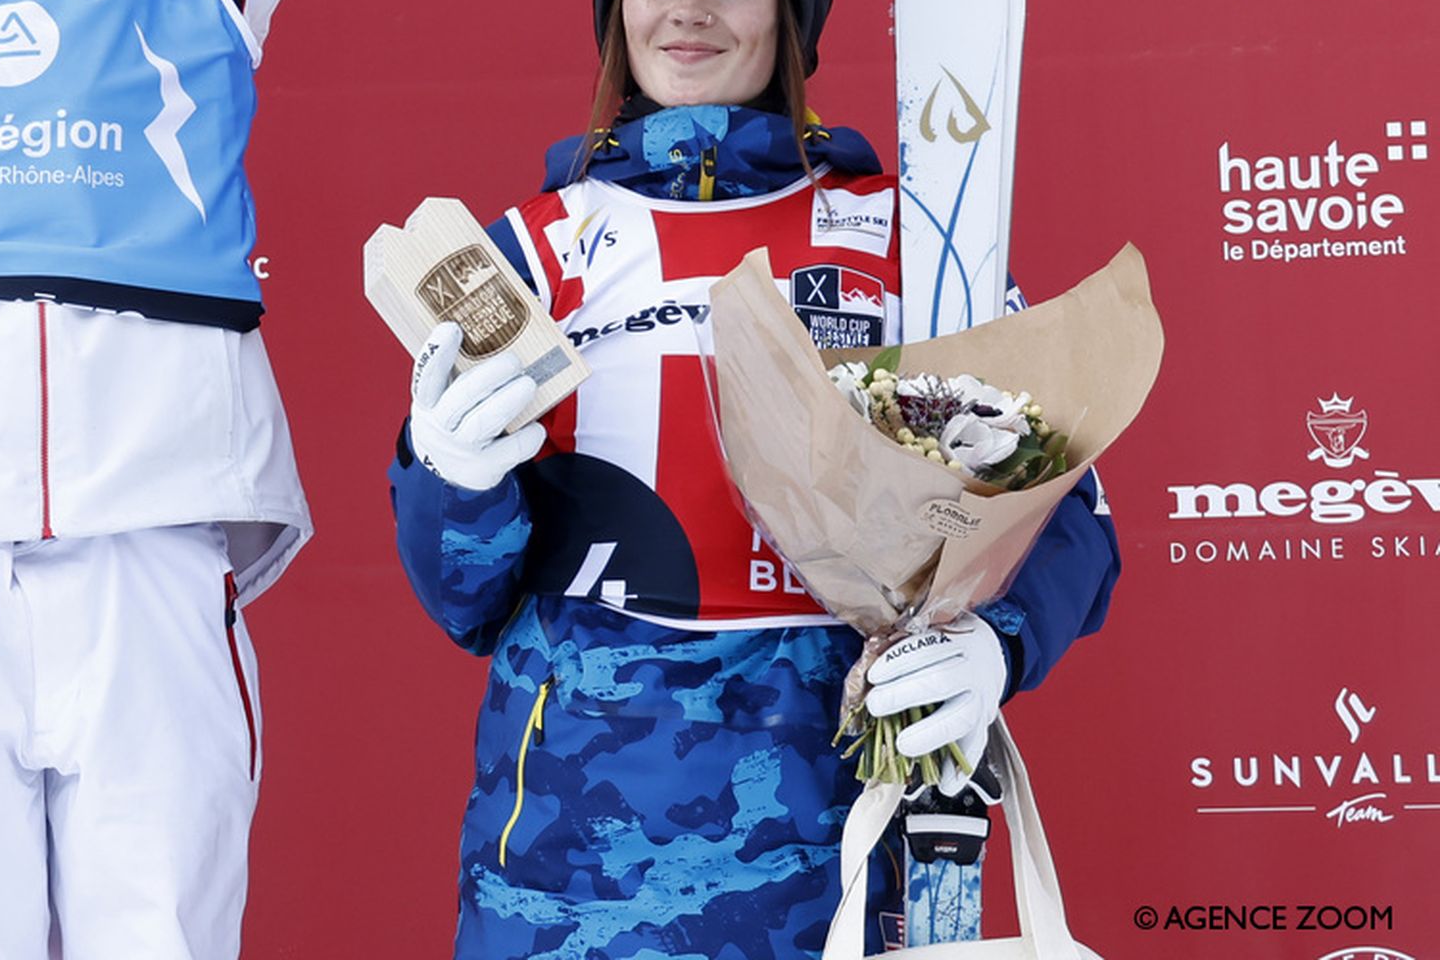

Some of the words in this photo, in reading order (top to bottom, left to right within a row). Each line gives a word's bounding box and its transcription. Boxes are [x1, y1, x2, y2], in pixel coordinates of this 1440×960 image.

[1218, 139, 1380, 192] haute
[1223, 191, 1405, 234] savoie
[1223, 241, 1245, 261] le
[1251, 235, 1407, 262] Département
[1169, 538, 1345, 564] DOMAINE
[1371, 535, 1440, 559] SKI
[886, 635, 938, 662] AUCLAIR
[1326, 792, 1394, 828] Team
